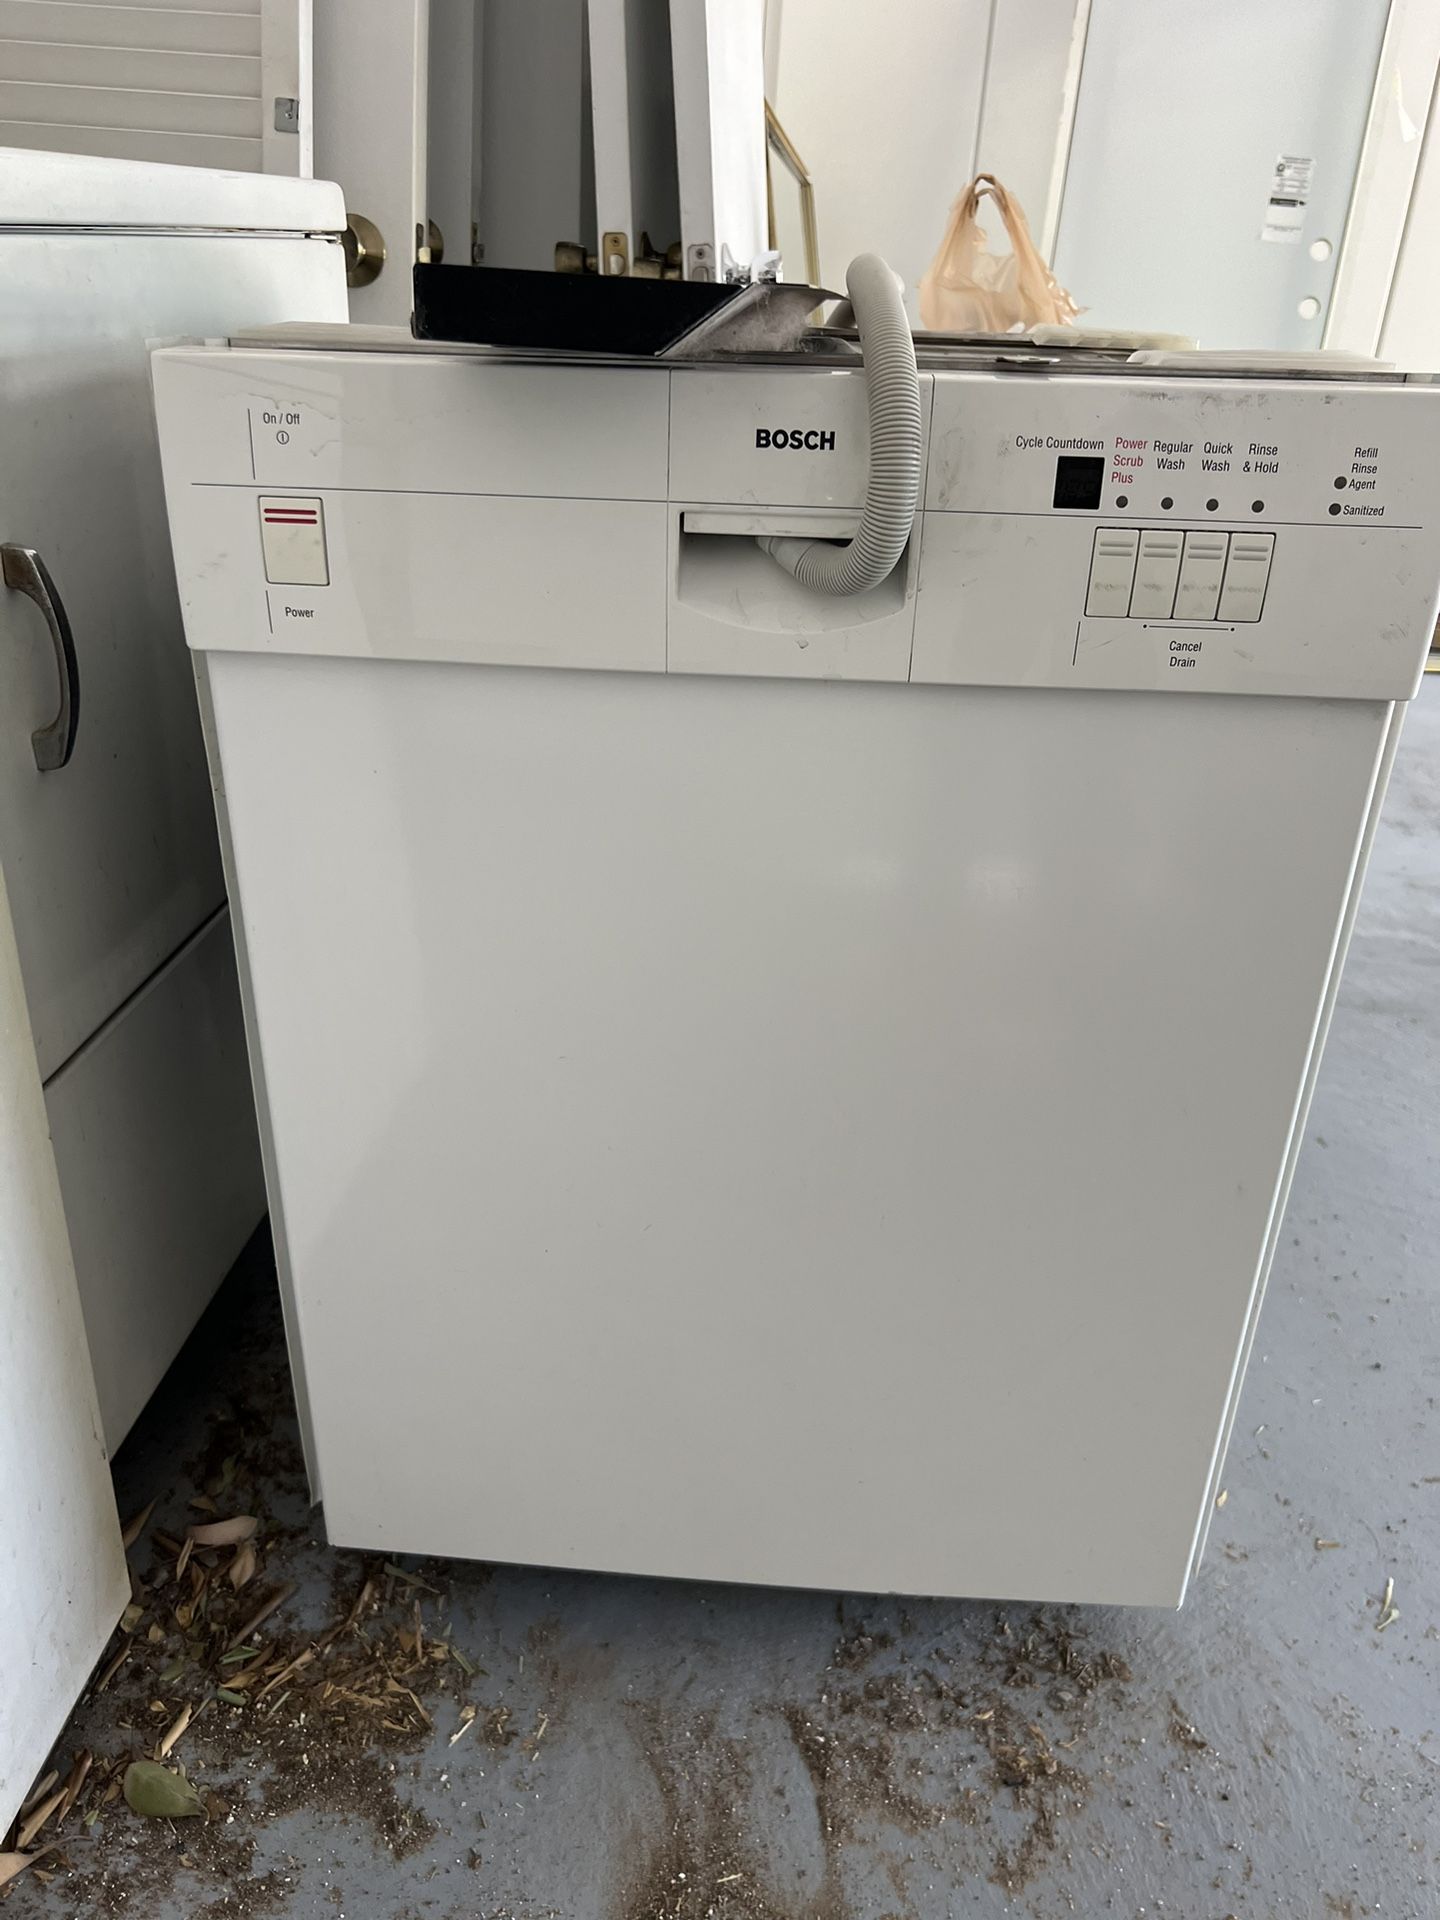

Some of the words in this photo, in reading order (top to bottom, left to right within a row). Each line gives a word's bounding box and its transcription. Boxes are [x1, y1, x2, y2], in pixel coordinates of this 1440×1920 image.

[263, 412, 277, 424] On
[286, 413, 301, 425] Off
[756, 429, 835, 450] BOSCH
[1016, 436, 1044, 450] Cycle
[1046, 437, 1104, 450] Countdown
[1115, 437, 1148, 450] Power
[1153, 441, 1193, 455] Regular
[1203, 442, 1233, 456] Quick
[1249, 443, 1278, 456] Rinse
[1354, 447, 1378, 458] Refill
[1113, 454, 1143, 467] Scrub
[1156, 457, 1185, 470] Wash
[1201, 459, 1230, 472] Wash
[1243, 461, 1252, 473] &
[1254, 461, 1279, 473] Hold
[1351, 463, 1377, 474] Rinse
[1112, 472, 1133, 483] Plus
[1348, 479, 1376, 491] Agent
[1343, 504, 1384, 516] Sanitized
[285, 606, 315, 618] Power
[1169, 640, 1202, 652] Cancel
[1169, 656, 1196, 667] Drain
